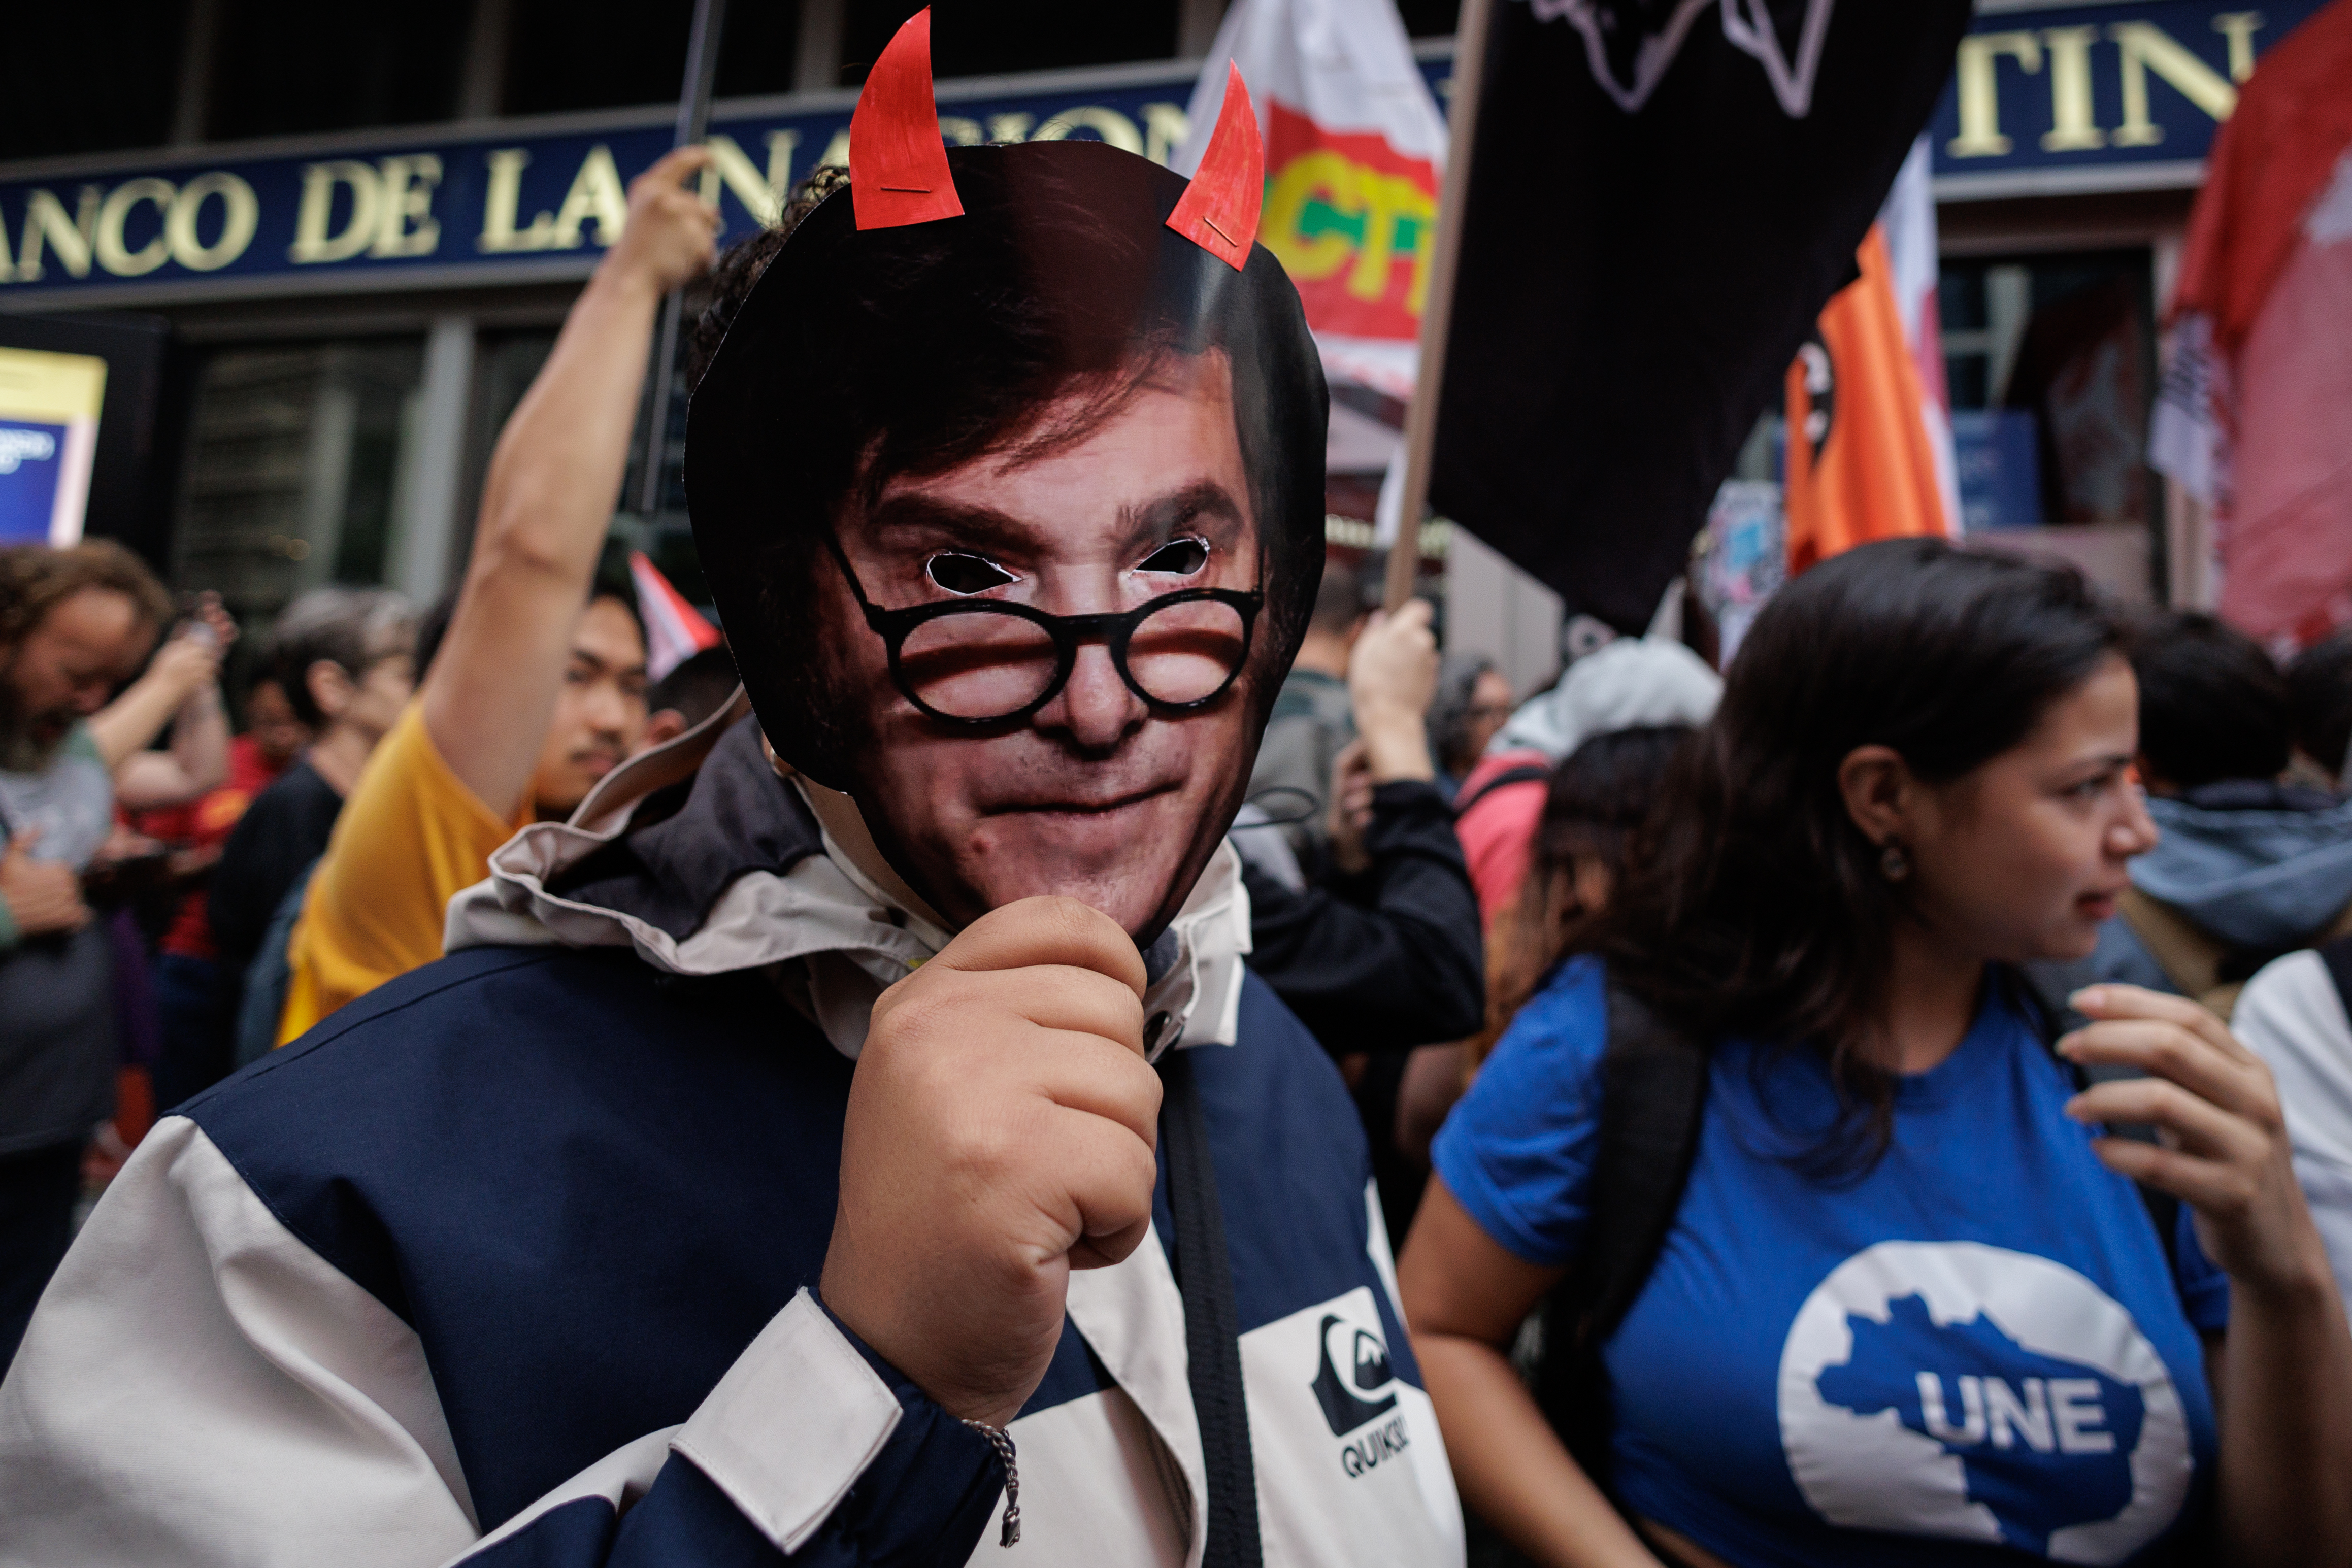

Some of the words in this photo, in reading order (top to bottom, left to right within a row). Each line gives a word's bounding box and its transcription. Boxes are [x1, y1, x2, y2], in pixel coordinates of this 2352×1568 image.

[0, 171, 259, 283] NCO
[288, 153, 443, 263] DE
[476, 144, 628, 253] LA
[1915, 1371, 2117, 1454] UNE
